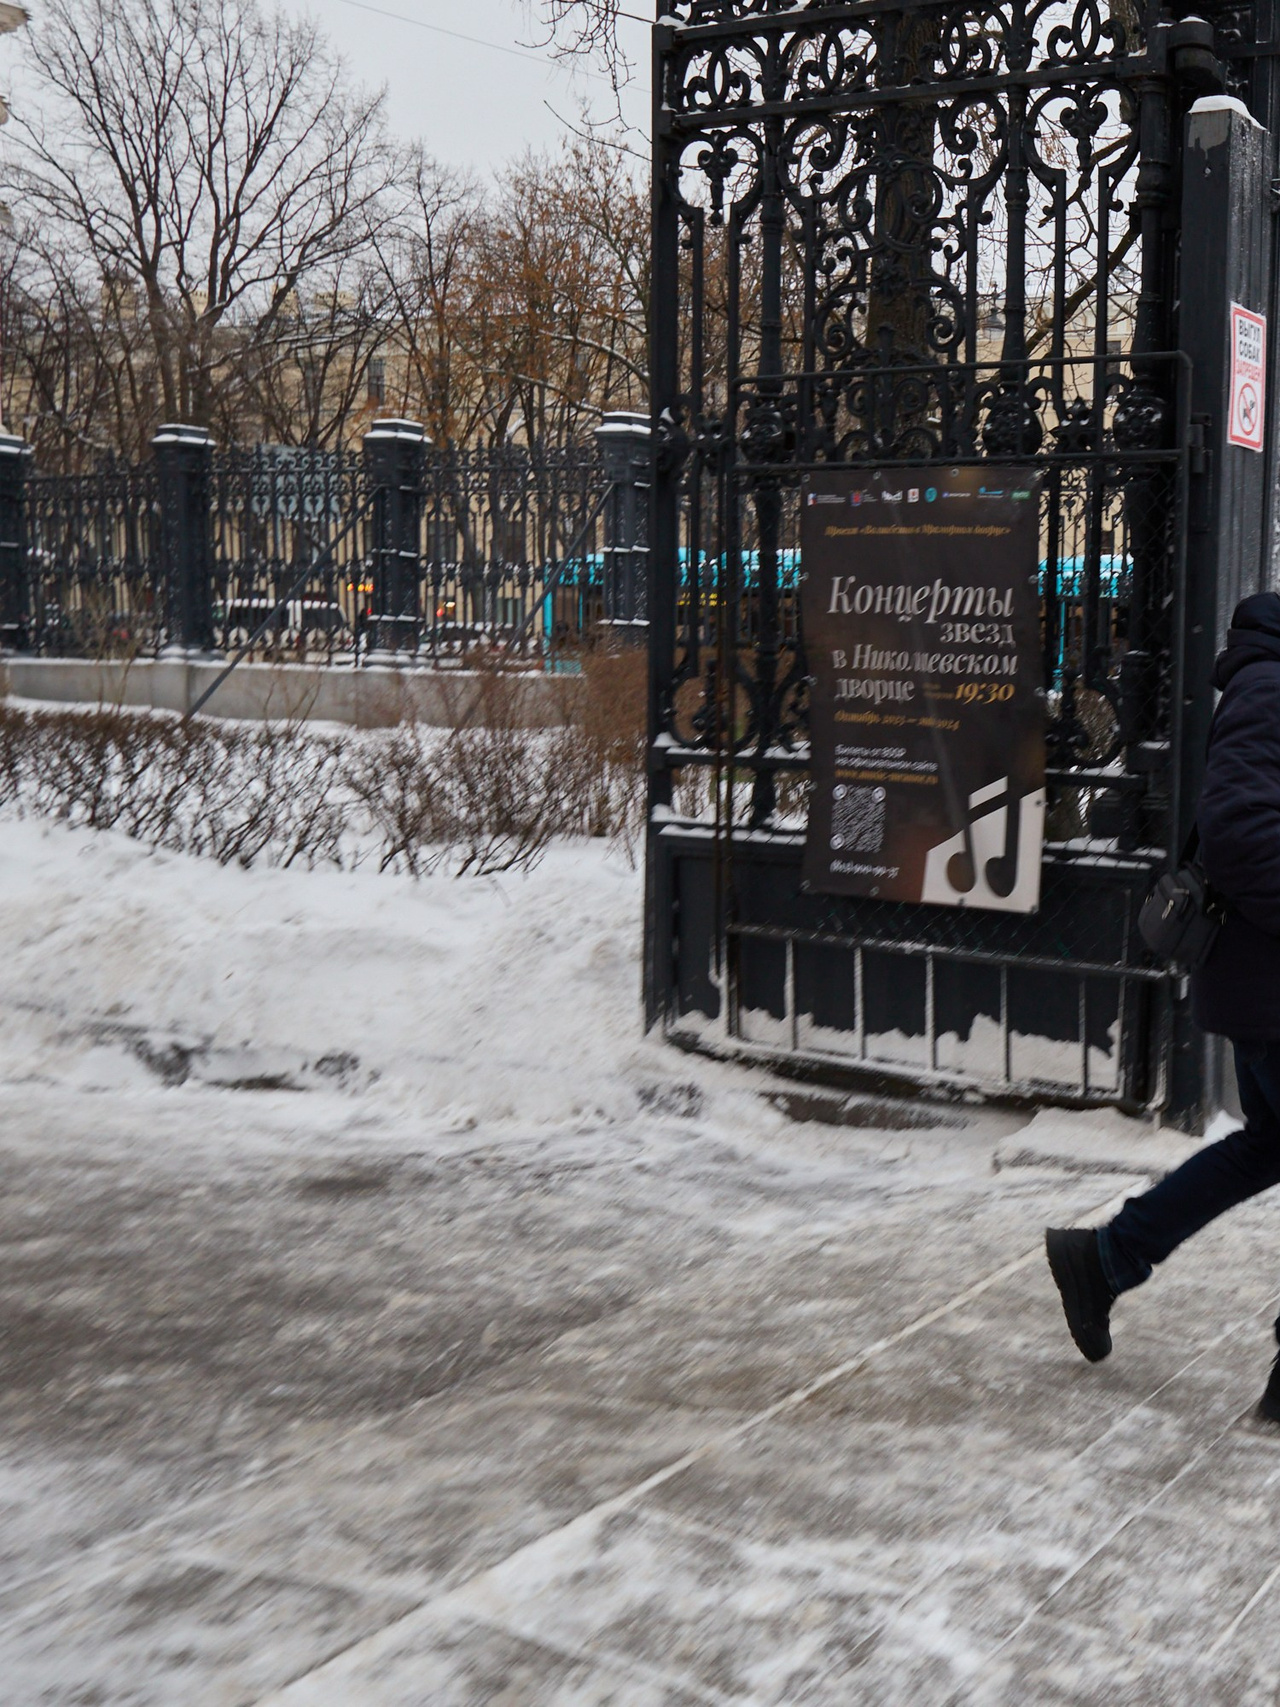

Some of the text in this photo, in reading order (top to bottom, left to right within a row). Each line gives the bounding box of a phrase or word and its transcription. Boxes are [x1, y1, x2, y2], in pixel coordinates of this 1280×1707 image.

[1239, 319, 1261, 343] ВЫГУЛ
[1239, 340, 1261, 364] СОБАК
[827, 575, 1014, 624] Концерты
[939, 622, 1016, 649] звезд
[832, 643, 1018, 676] в Николаевском
[834, 678, 1015, 705] дворце 19:30
